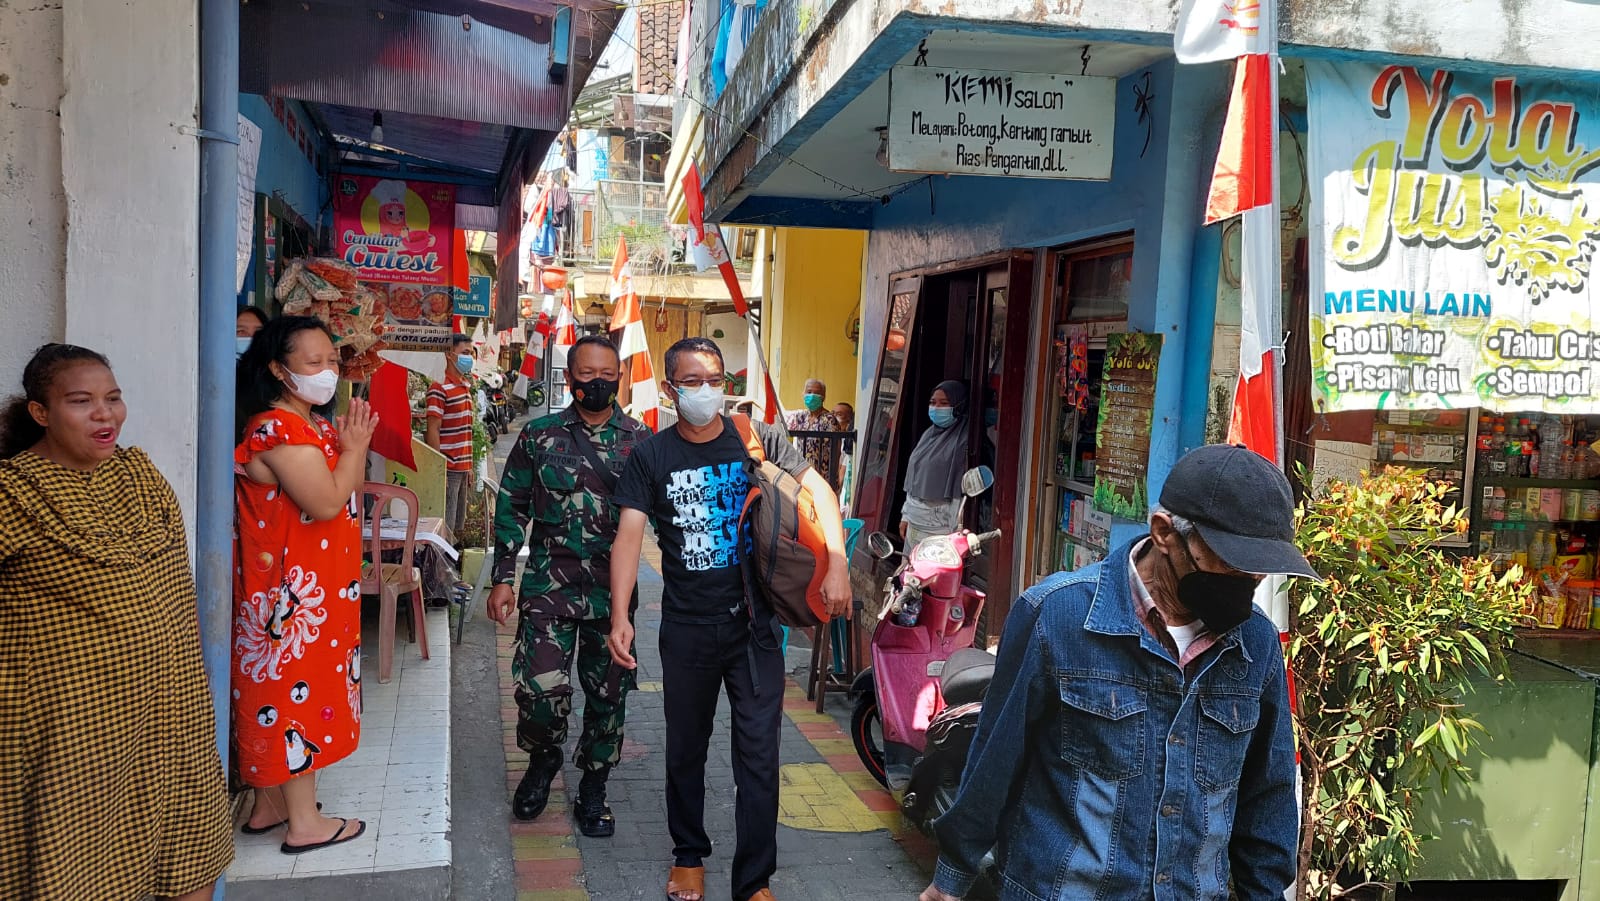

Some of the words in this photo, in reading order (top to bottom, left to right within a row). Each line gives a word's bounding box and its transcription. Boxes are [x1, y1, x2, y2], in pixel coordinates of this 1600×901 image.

[1370, 65, 1583, 170] Yola
[1332, 140, 1486, 265] Jus
[343, 229, 402, 247] Cemilan
[344, 244, 443, 274] Cutest
[458, 303, 486, 312] WANITA
[1324, 288, 1415, 315] MENU
[1424, 293, 1492, 317] LAIN
[425, 328, 449, 336] paduan
[1335, 325, 1387, 354] Roti
[1389, 324, 1446, 356] Bakar
[1498, 328, 1556, 359] Tahu
[1109, 356, 1133, 369] Yola
[1496, 366, 1591, 397] Sempol
